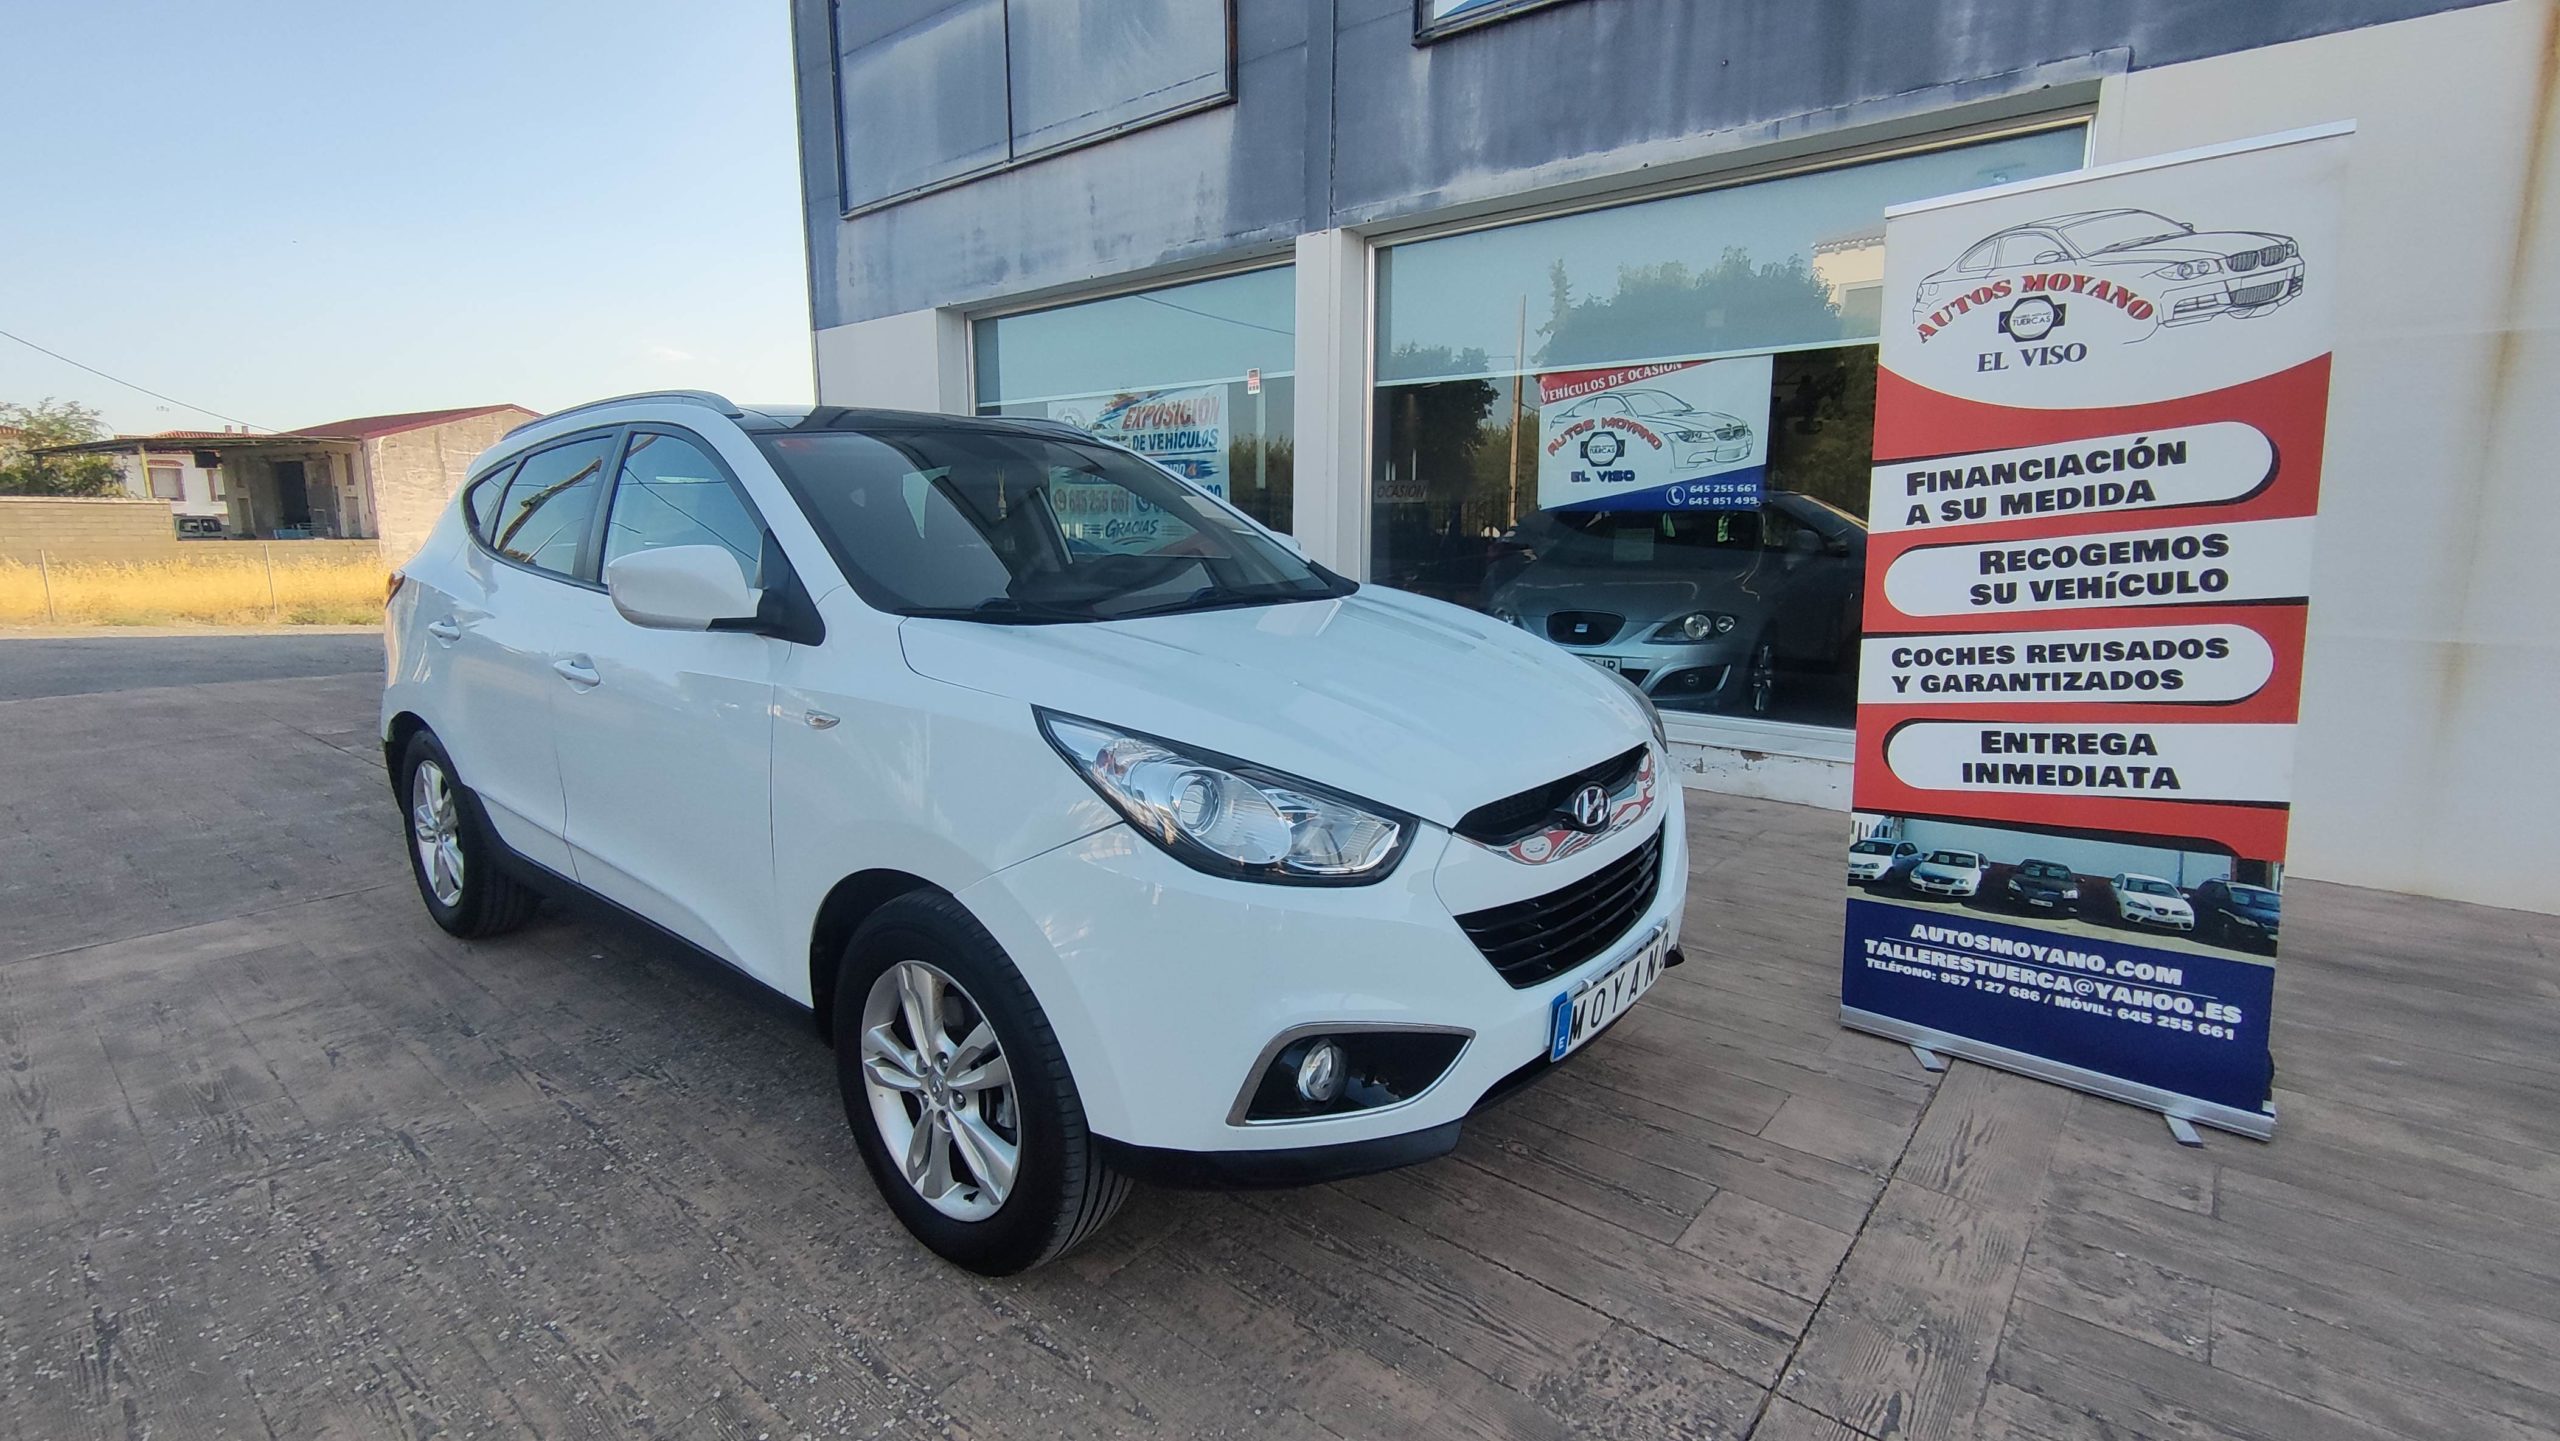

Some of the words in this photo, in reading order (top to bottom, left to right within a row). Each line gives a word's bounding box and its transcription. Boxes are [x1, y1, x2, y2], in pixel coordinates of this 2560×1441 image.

[1916, 279, 2012, 344] AUTOS
[2021, 273, 2154, 321] MOYANO
[2012, 315, 2051, 326] TUERCAS
[1976, 351, 2009, 373] EL
[2020, 342, 2088, 367] VISO
[1541, 378, 1606, 405] VEHÍCULOS
[1608, 371, 1625, 385] DE
[1133, 434, 1145, 451] DE
[1149, 428, 1219, 450] VEHÍCULOS
[1547, 418, 1595, 457] AUTOS
[1601, 416, 1663, 451] MOYANO
[1571, 471, 1590, 483] EL
[1597, 469, 1635, 483] VISO
[1906, 437, 2187, 496] FINANCIACIÓN
[1688, 497, 1710, 505] 645
[1712, 497, 1732, 505] 851
[1734, 496, 1757, 505] 499
[1690, 484, 1710, 493] 645
[1713, 484, 1734, 492] 255
[1737, 483, 1757, 492] 661
[1905, 504, 1931, 526] A
[1940, 497, 1987, 521] SU
[2000, 479, 2156, 516] MEDIDA
[1105, 518, 1159, 538] GRACIAS
[1979, 533, 2230, 575] RECOGEMOS
[1969, 582, 2017, 605] SU
[2029, 568, 2229, 602] VEHÍCULO
[1891, 645, 2015, 668] COCHES
[2026, 637, 2230, 663] REVISADOS
[1891, 675, 1911, 694] Y
[1920, 668, 2184, 693] GARANTIZADOS
[1981, 730, 2158, 756] ENTREGA
[1962, 762, 2181, 789] INMEDIATA
[1910, 923, 2183, 986] AUTOSMOYANO.COM
[1864, 939, 2242, 1024] TALLERESTUERCA@YAHOO.ES
[1866, 957, 1937, 983] TELÉFONO:
[1941, 972, 1970, 988] 957
[1974, 978, 2005, 994] 127
[2009, 986, 2040, 1003] 686
[2055, 995, 2112, 1017] MÓVIL:
[2117, 1007, 2152, 1026] 645
[2156, 1015, 2193, 1033] 255
[2198, 1023, 2235, 1041] 661
[1558, 1036, 1566, 1049] E
